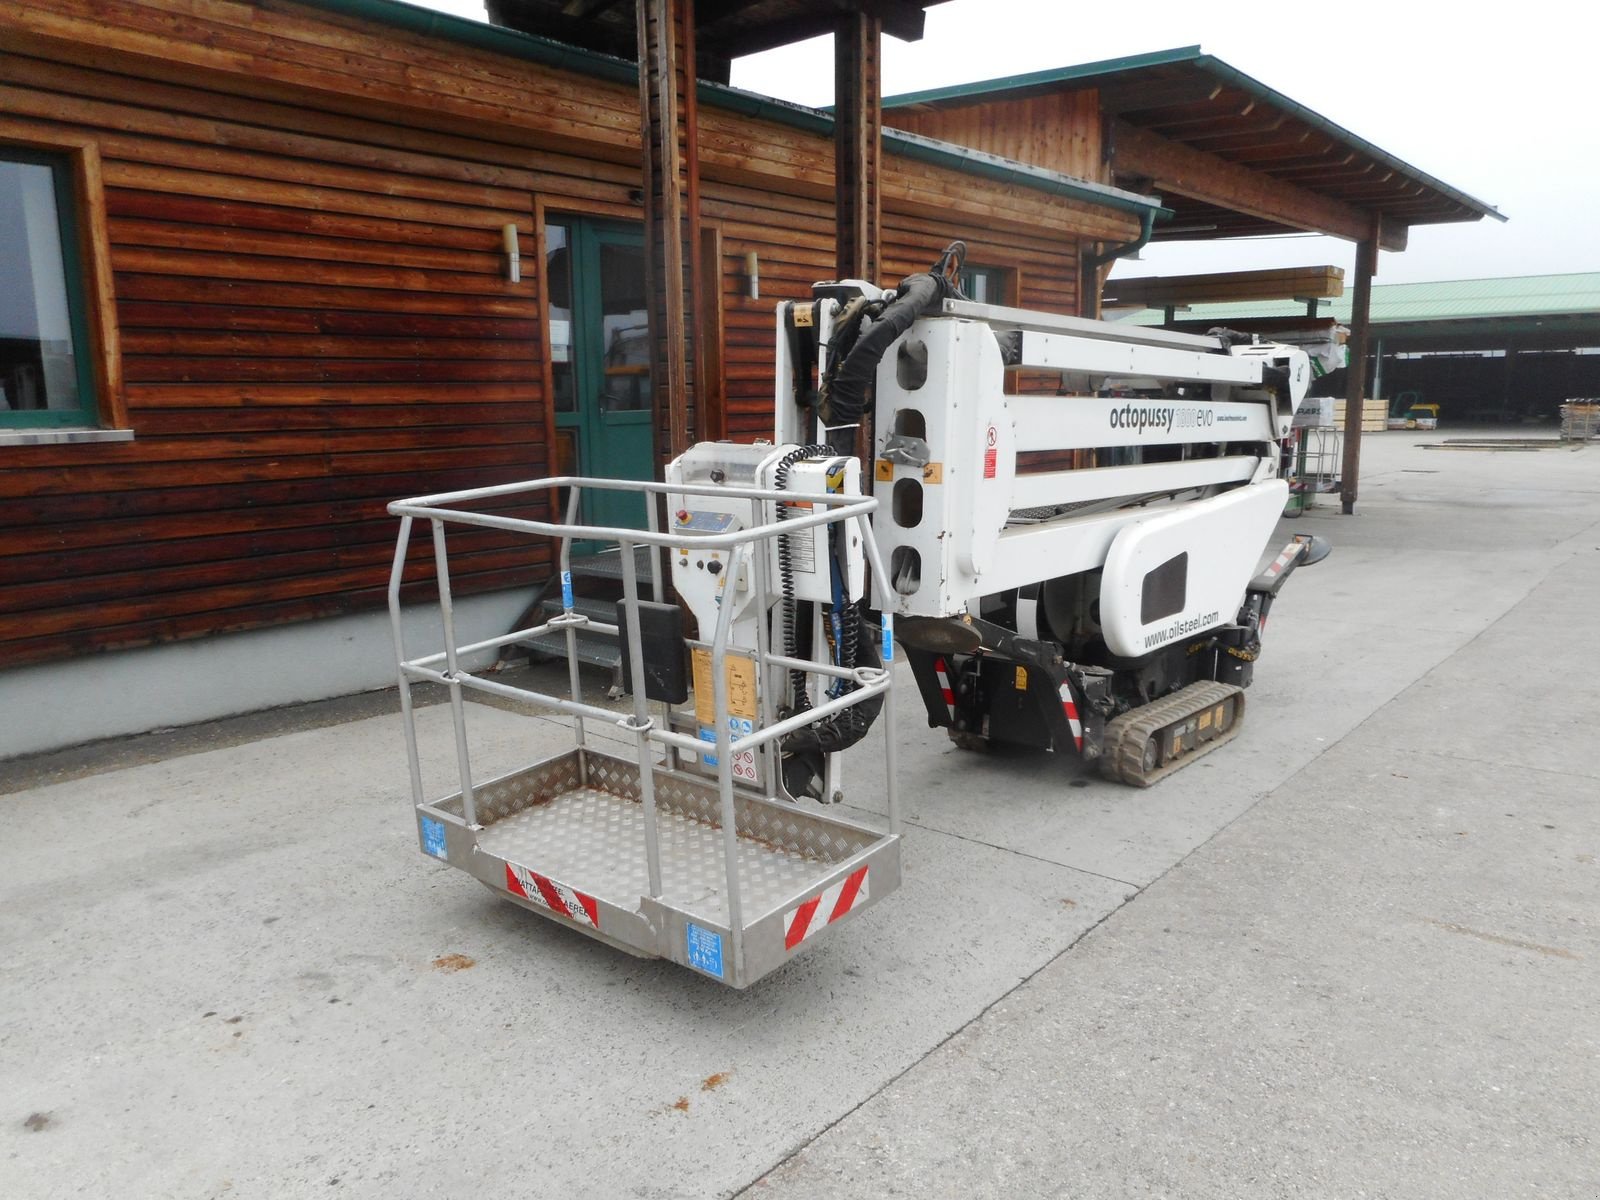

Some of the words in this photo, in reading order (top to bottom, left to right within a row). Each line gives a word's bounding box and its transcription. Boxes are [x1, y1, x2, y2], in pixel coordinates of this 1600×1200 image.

[1109, 404, 1174, 434] octopussy
[1196, 408, 1213, 427] evo
[1144, 611, 1219, 648] www.oilsteel.com
